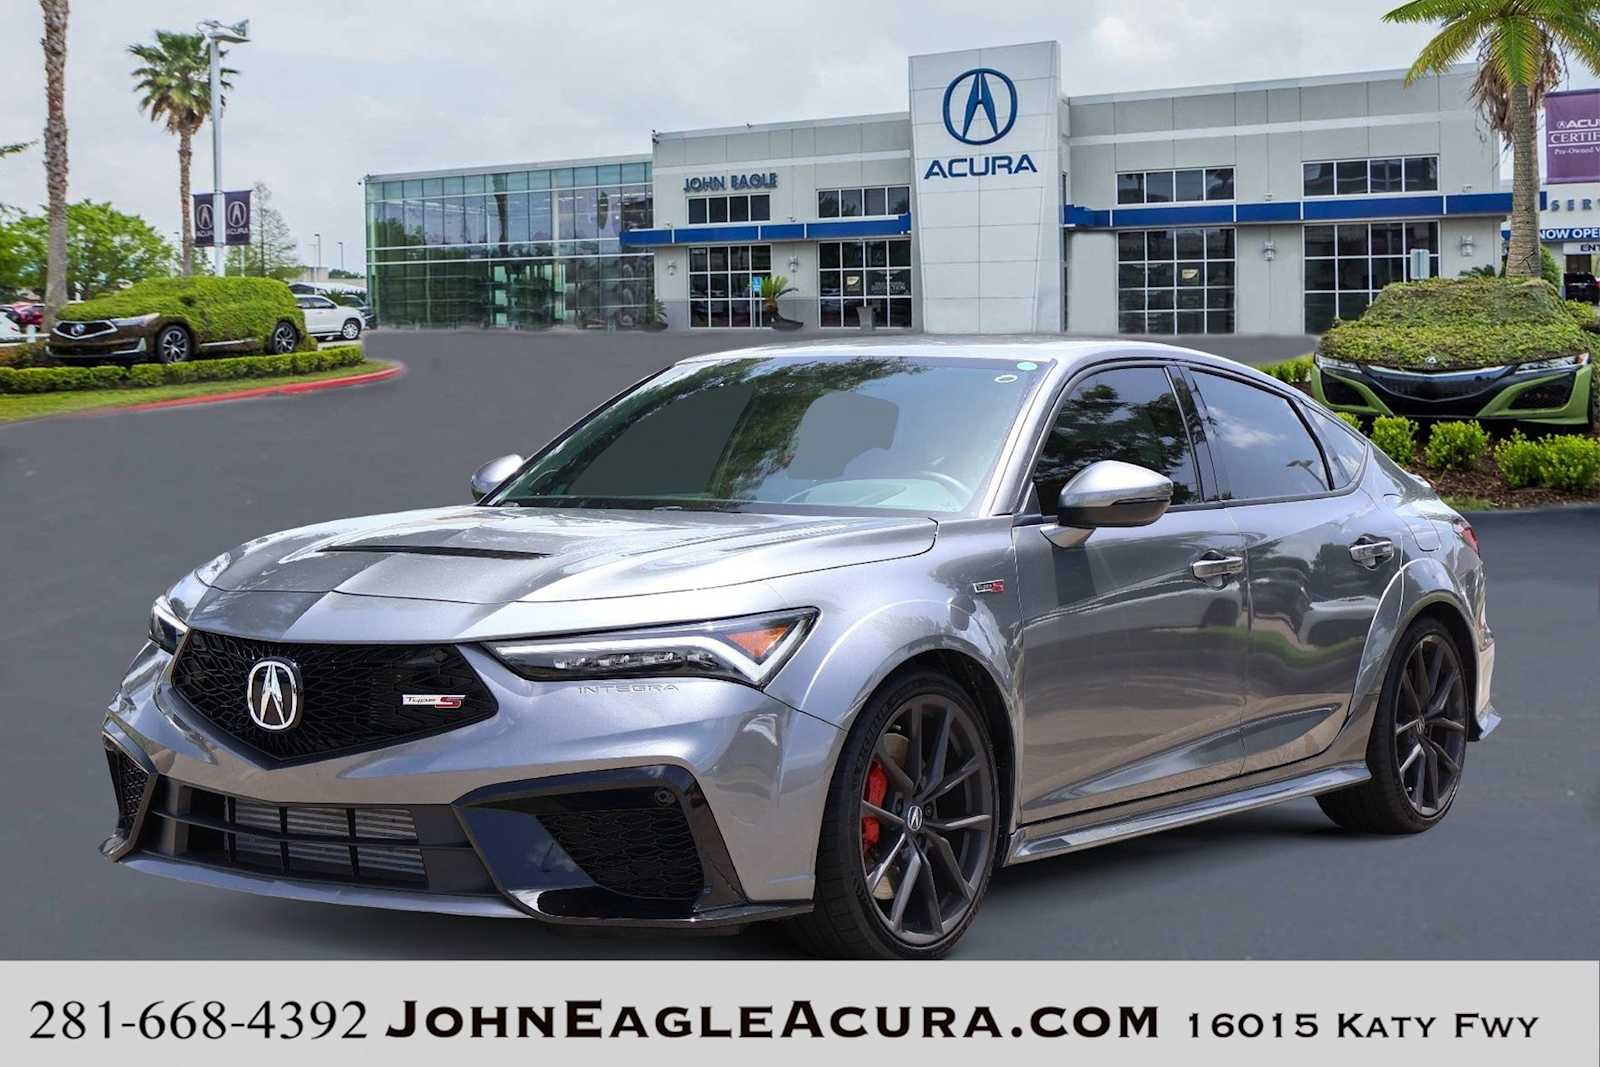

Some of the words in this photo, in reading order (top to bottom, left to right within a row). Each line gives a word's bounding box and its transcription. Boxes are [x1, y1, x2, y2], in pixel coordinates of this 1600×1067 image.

[1567, 119, 1600, 128] ACU
[924, 154, 1037, 179] ACURA
[683, 176, 726, 192] JOHN
[731, 172, 777, 190] EAGLE
[578, 682, 681, 695] INTEGRA
